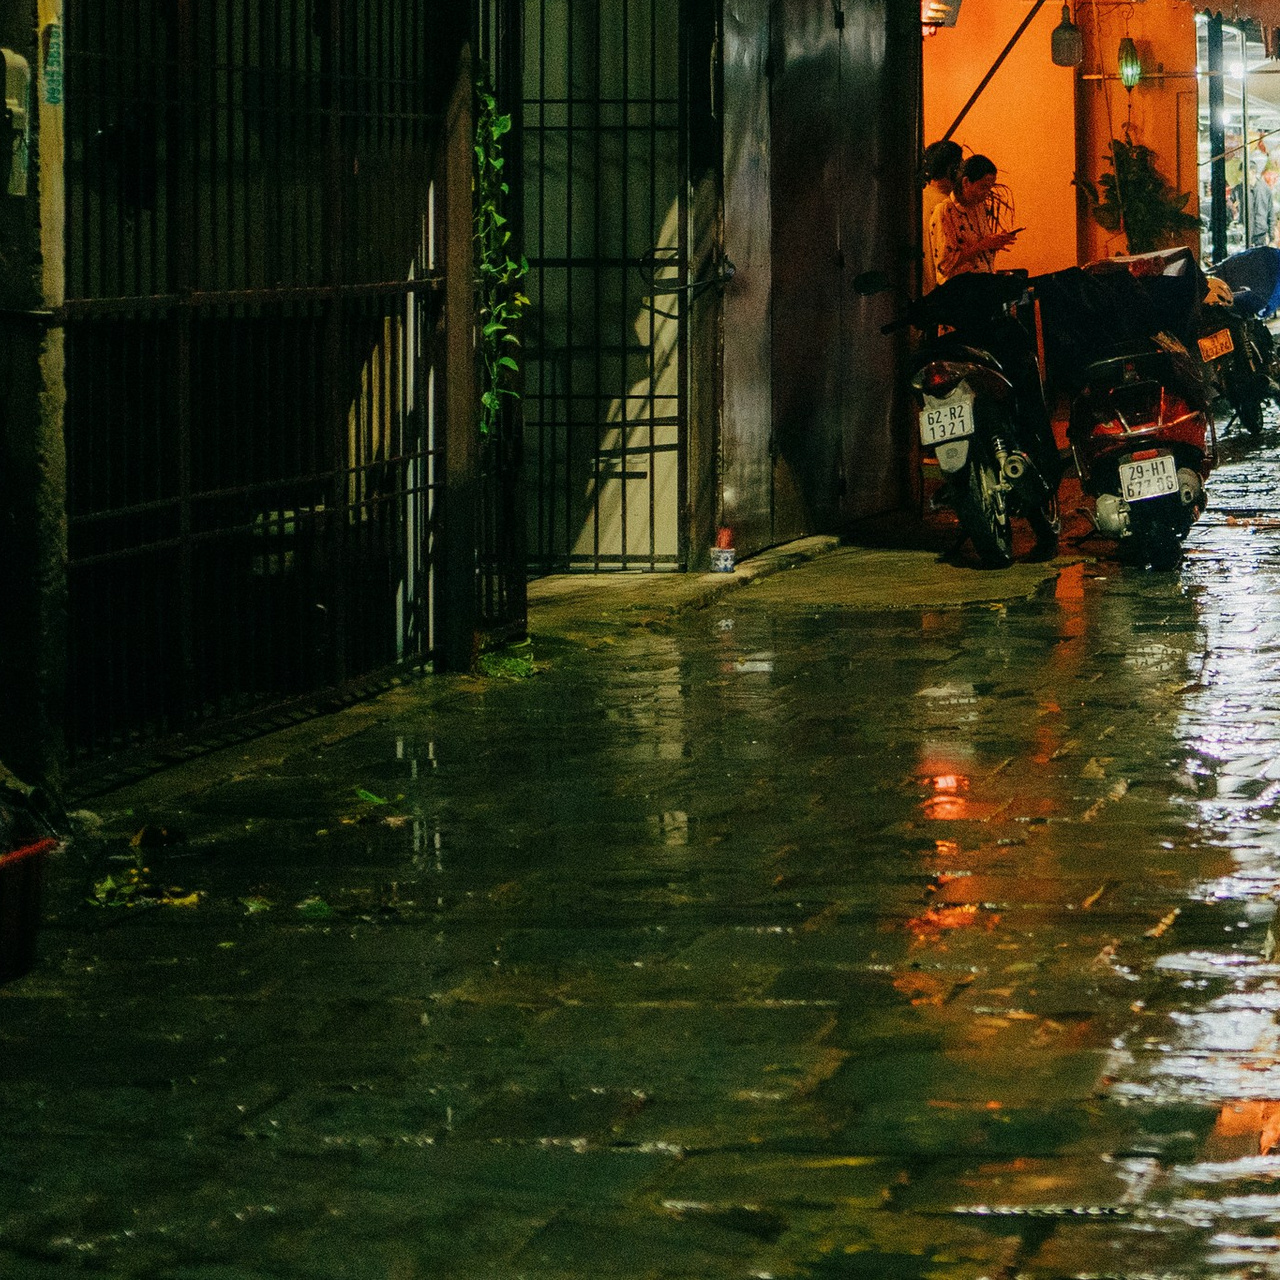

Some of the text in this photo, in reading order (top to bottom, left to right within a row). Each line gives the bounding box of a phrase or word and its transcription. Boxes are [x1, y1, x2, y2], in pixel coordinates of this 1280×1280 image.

[927, 404, 964, 425] 62-R2
[930, 419, 965, 439] 1321
[1129, 461, 1166, 480] 29-H1
